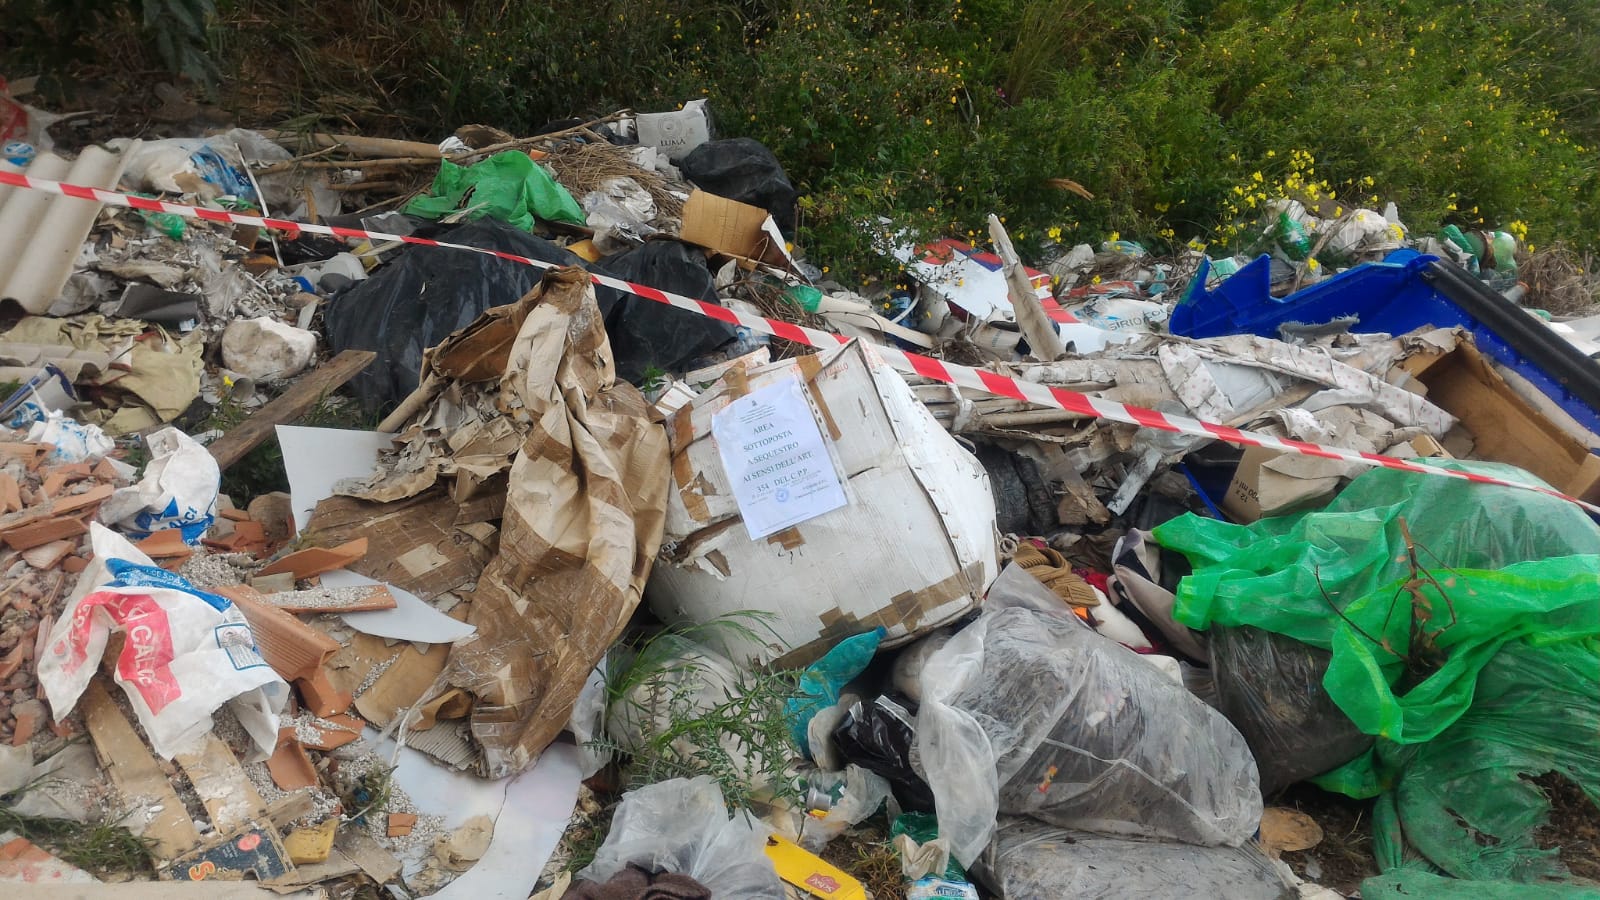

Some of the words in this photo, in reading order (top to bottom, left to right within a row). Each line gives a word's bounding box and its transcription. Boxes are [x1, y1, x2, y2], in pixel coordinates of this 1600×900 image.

[660, 138, 686, 147] LUMA
[1110, 317, 1142, 331] SIRIO
[753, 422, 774, 435] AREA
[743, 430, 793, 452] SOTTOPOSTA
[753, 441, 799, 465] SEQUESTRO
[743, 475, 752, 483] AI
[751, 465, 775, 480] SENSI
[774, 475, 790, 486] DEL
